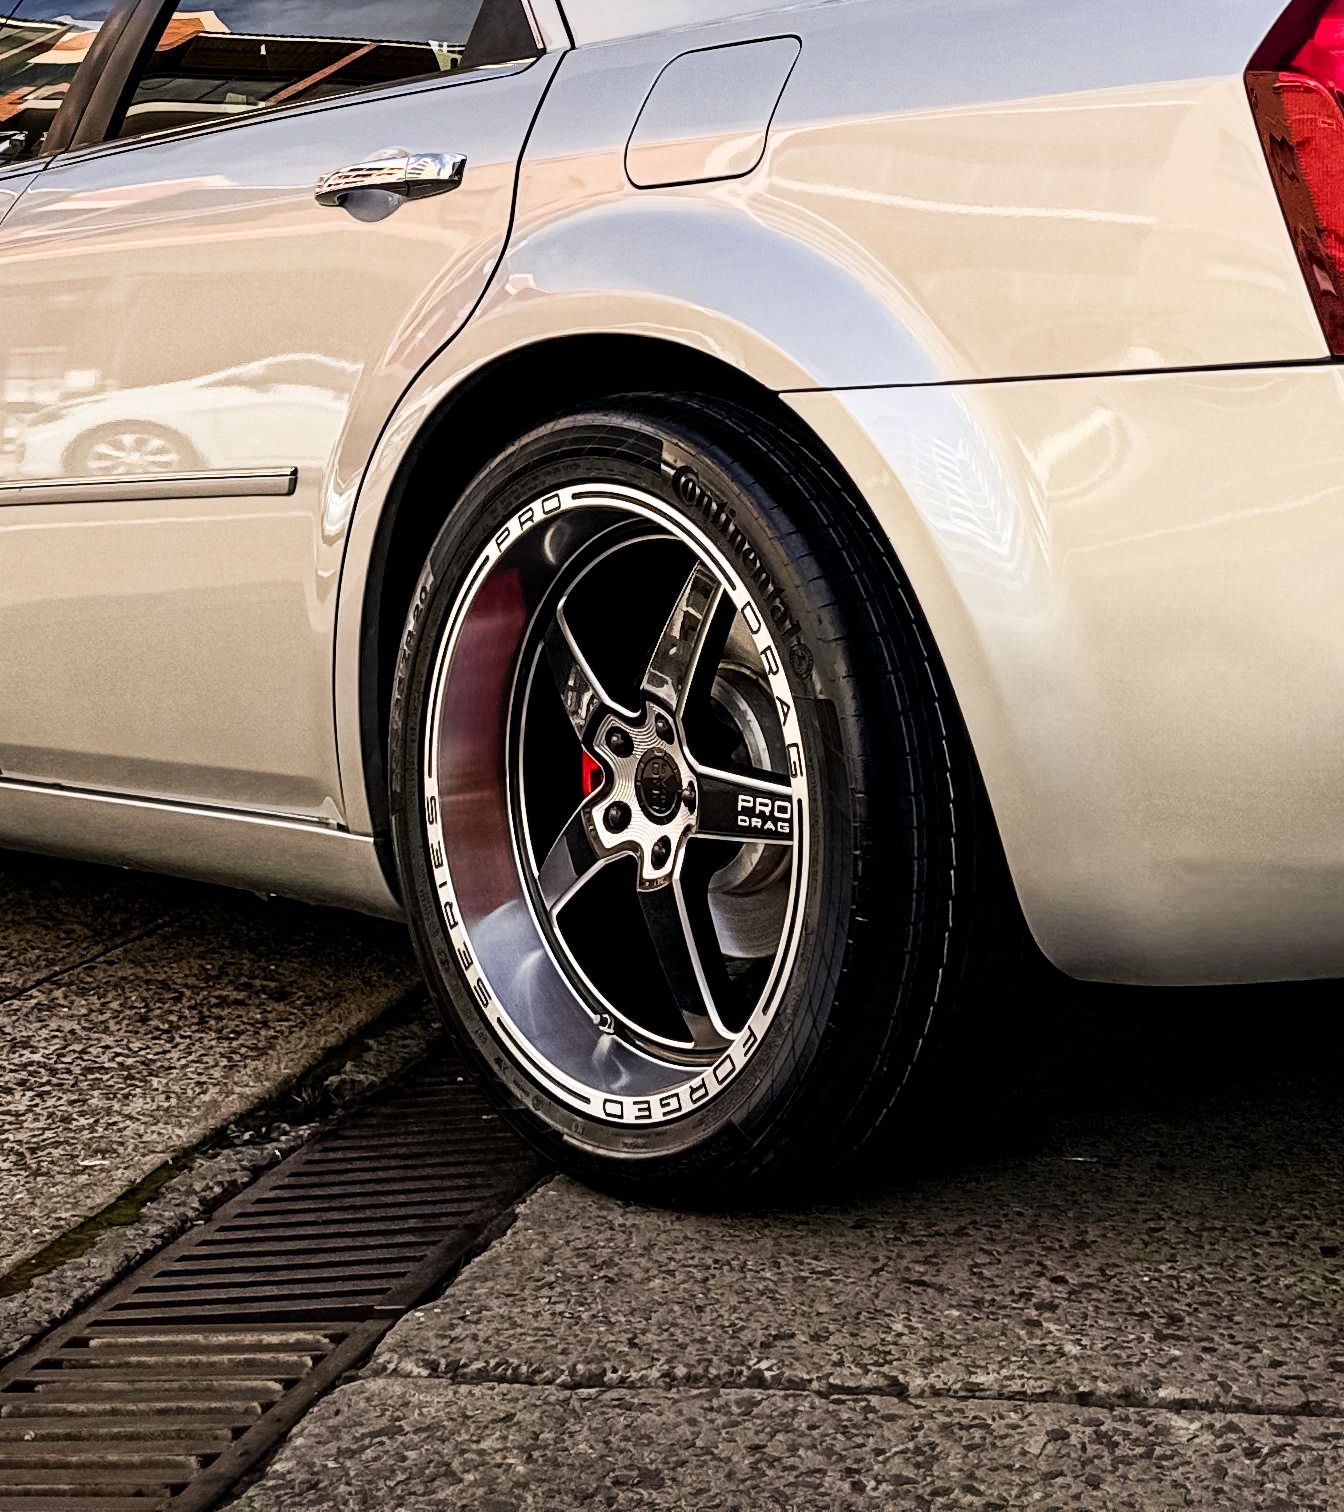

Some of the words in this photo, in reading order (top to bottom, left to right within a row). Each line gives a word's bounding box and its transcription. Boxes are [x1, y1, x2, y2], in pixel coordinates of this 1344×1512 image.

[495, 493, 561, 553] PRO
[672, 465, 802, 637] Continental
[741, 601, 803, 778] DRAG
[737, 794, 791, 819] PRO
[737, 816, 790, 833] DRAG
[425, 794, 493, 1009] SERIES
[602, 1024, 758, 1121] FORGED
